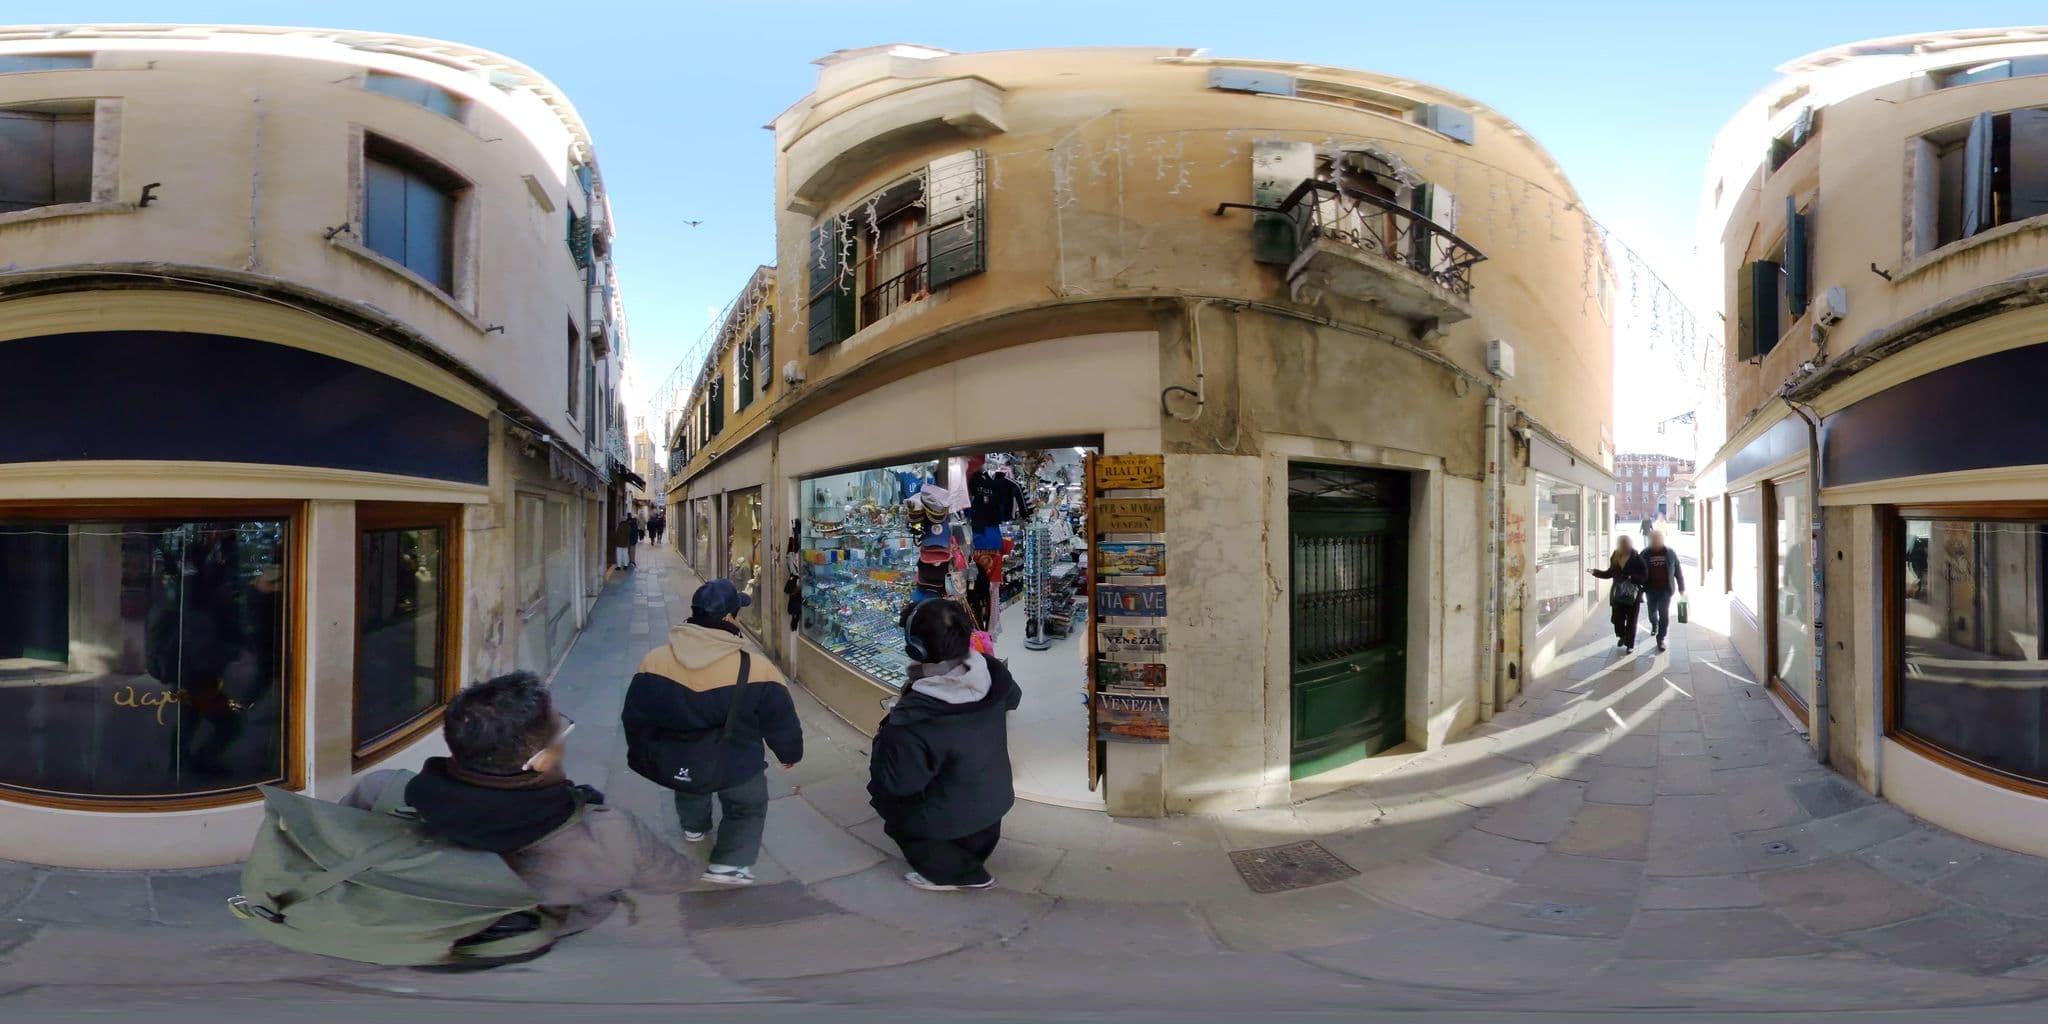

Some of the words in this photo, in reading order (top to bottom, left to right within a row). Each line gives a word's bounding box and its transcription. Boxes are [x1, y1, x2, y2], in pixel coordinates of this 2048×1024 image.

[1104, 465, 1153, 476] RIALTO
[1111, 521, 1150, 529] VENEZIA
[1107, 636, 1160, 646] VENEZIA
[1101, 694, 1165, 712] VENEZIA
